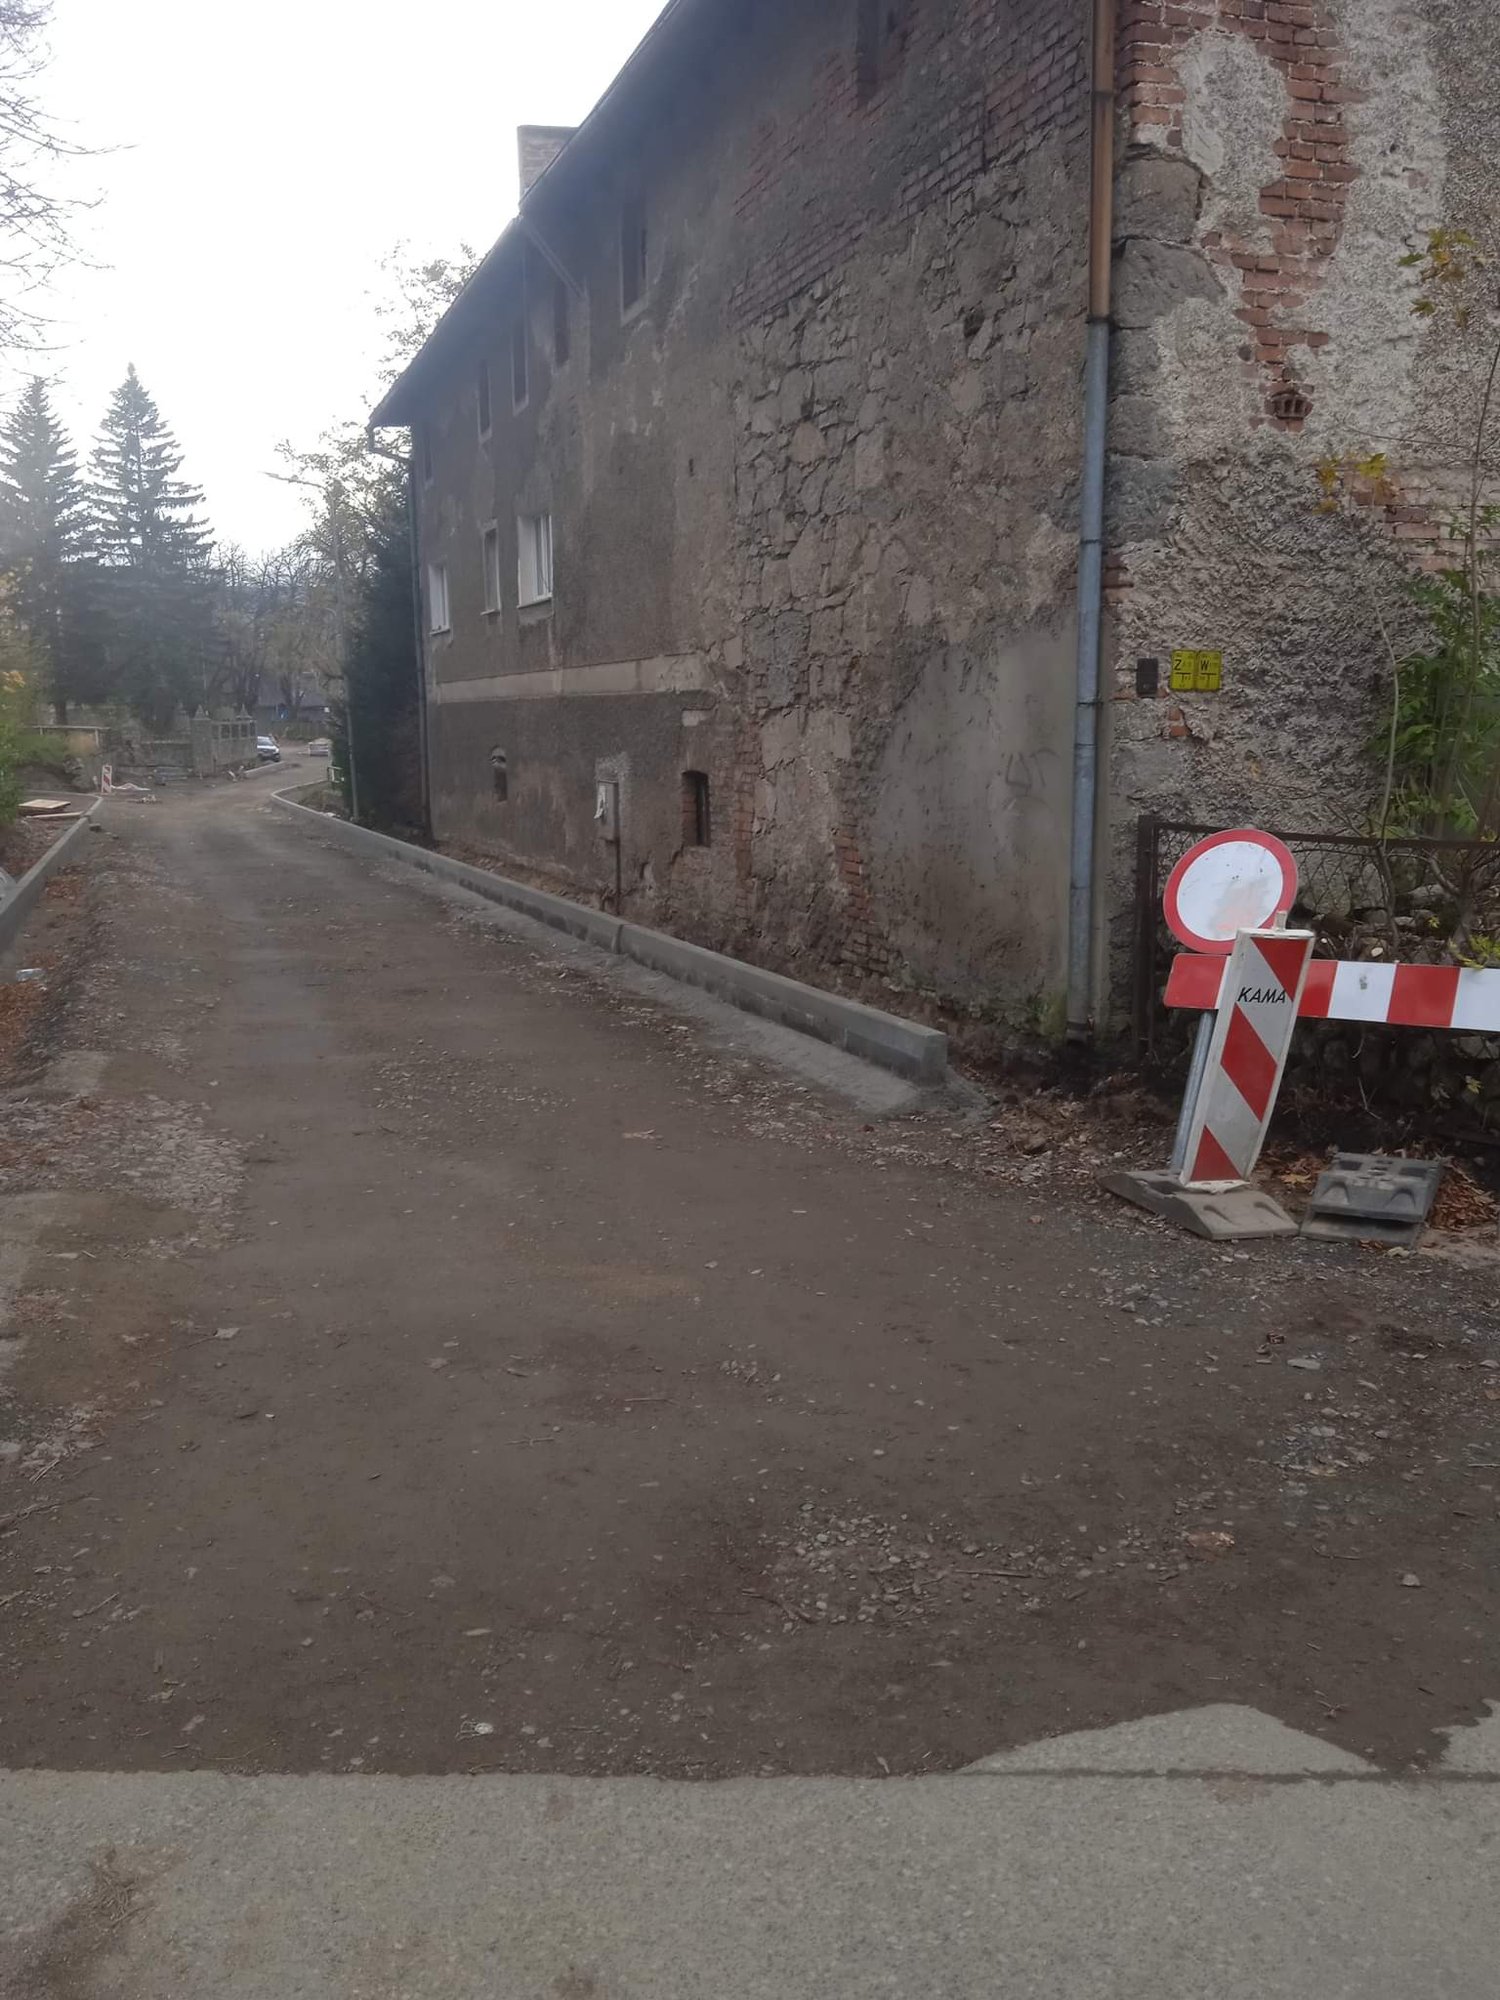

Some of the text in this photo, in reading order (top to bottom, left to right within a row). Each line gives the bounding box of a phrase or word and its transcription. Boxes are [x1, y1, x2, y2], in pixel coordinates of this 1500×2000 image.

[1174, 659, 1182, 671] Z
[1201, 660, 1209, 671] W
[1237, 986, 1286, 1004] KAMA
